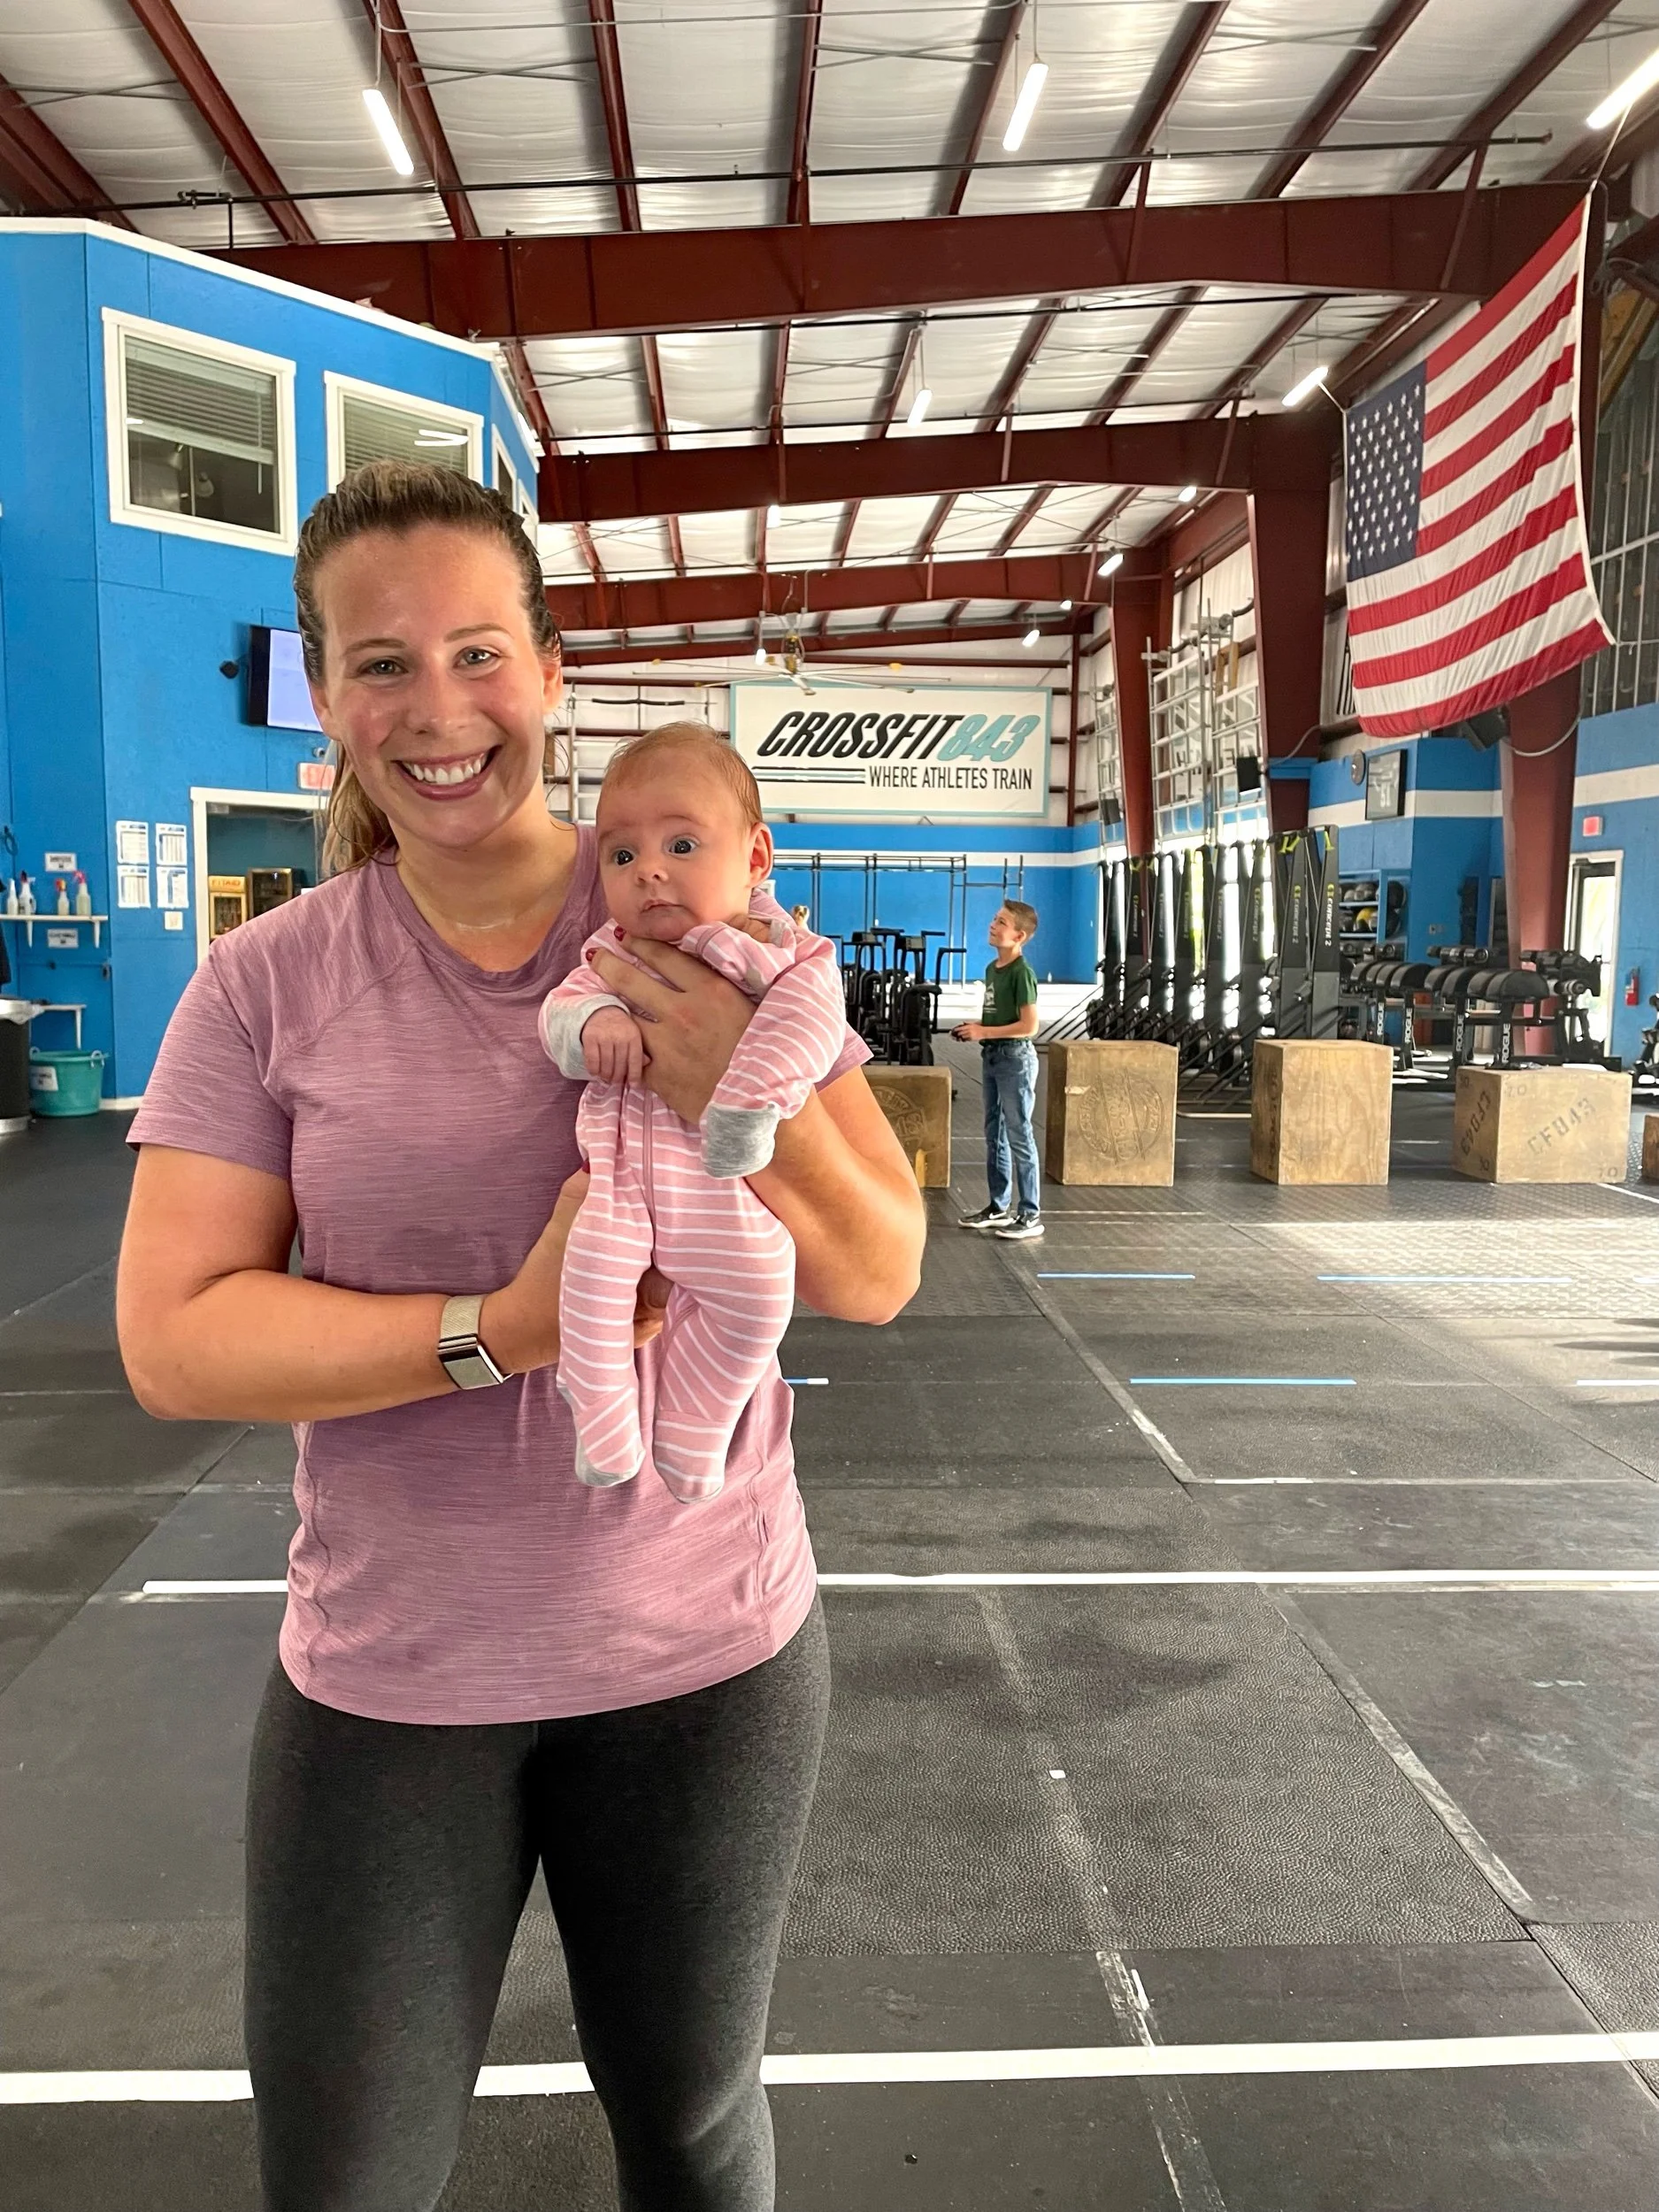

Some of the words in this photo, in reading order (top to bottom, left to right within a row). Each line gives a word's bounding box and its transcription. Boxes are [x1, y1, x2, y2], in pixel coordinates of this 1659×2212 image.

[870, 765, 918, 788] WHERE
[922, 767, 987, 789] ATHLETES
[993, 768, 1033, 789] TRAIN
[1404, 1007, 1413, 1044] ROGUE
[1455, 1014, 1464, 1052] ROGUE
[1502, 1023, 1511, 1063] ROGUE
